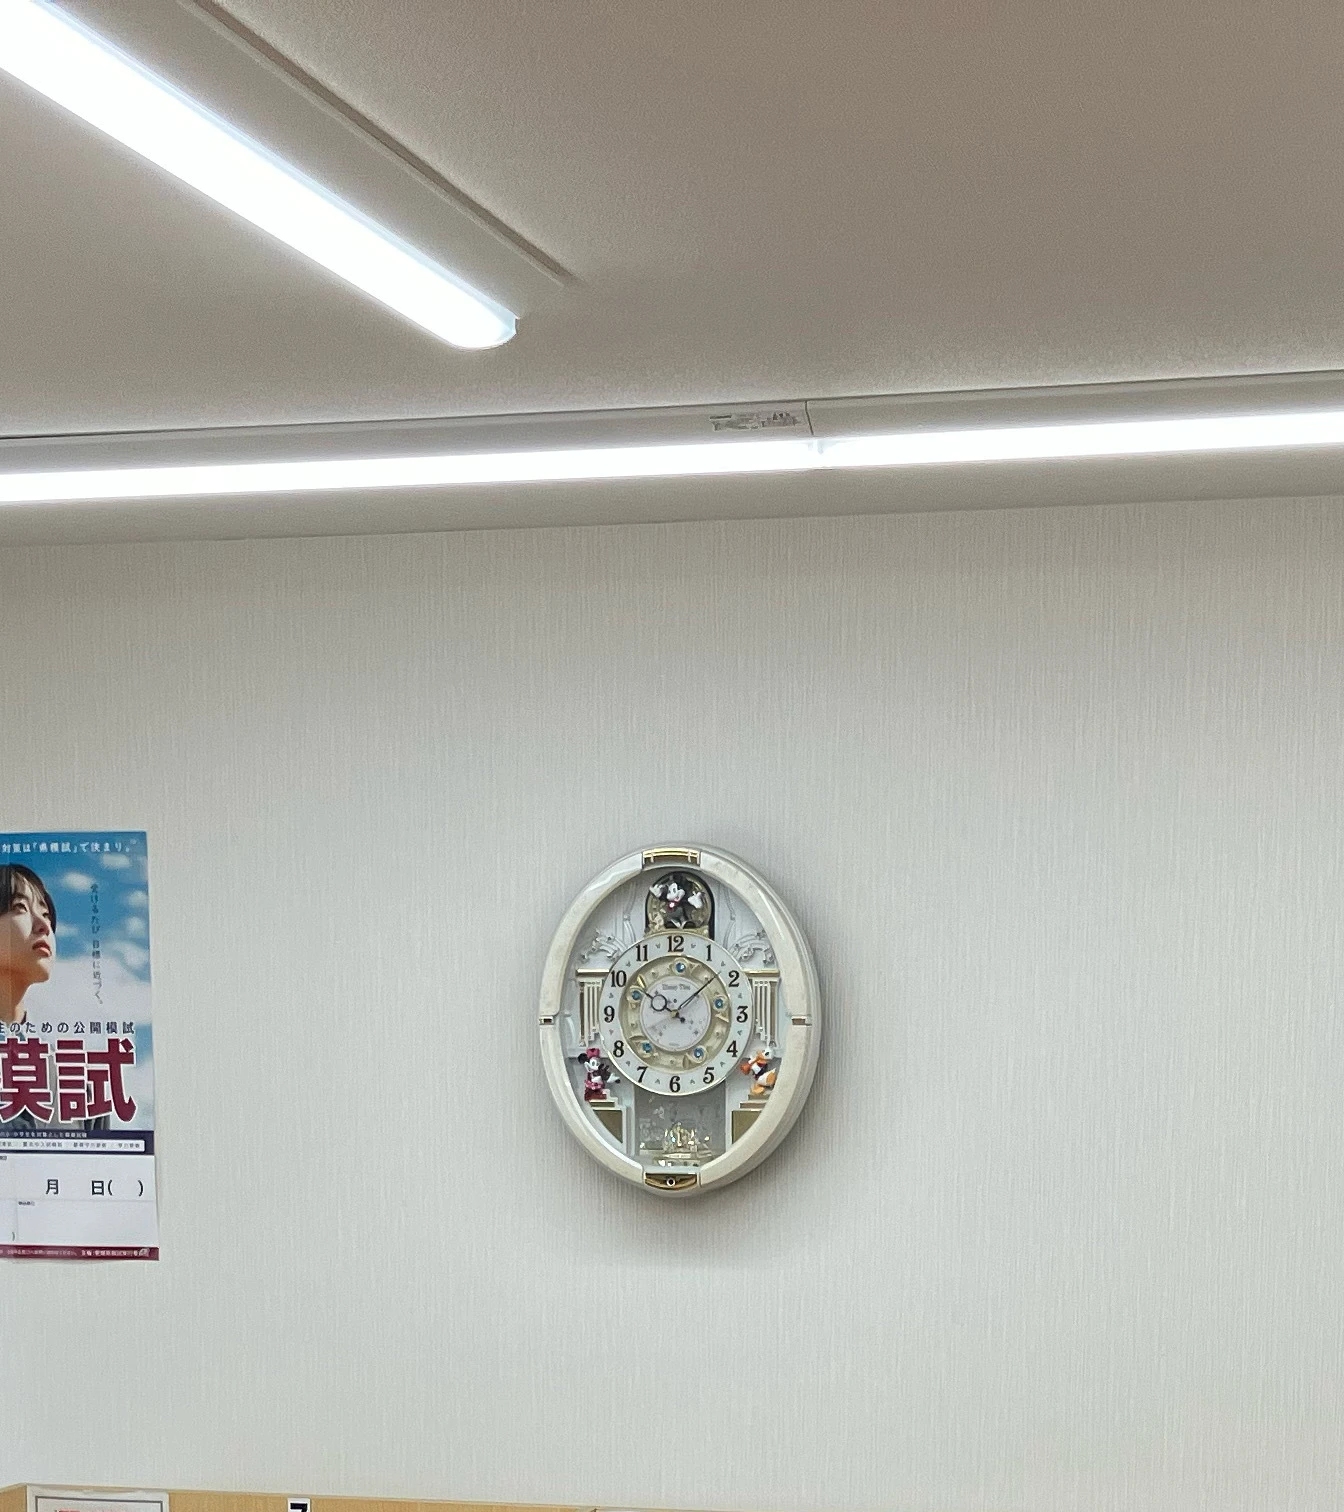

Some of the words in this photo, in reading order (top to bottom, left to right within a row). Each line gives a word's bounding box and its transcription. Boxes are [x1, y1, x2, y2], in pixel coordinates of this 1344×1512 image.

[667, 935, 684, 952] 12
[636, 946, 649, 961] 11
[706, 945, 713, 961] 1
[610, 970, 627, 987] 10
[728, 970, 740, 987] 2
[604, 1006, 615, 1022] 9
[736, 1006, 748, 1022] 3
[613, 1040, 624, 1057] 8
[726, 1040, 738, 1056] 4
[637, 1066, 648, 1083] 7
[703, 1066, 715, 1084] 5
[669, 1076, 680, 1093] 6
[45, 1179, 59, 1195] 月
